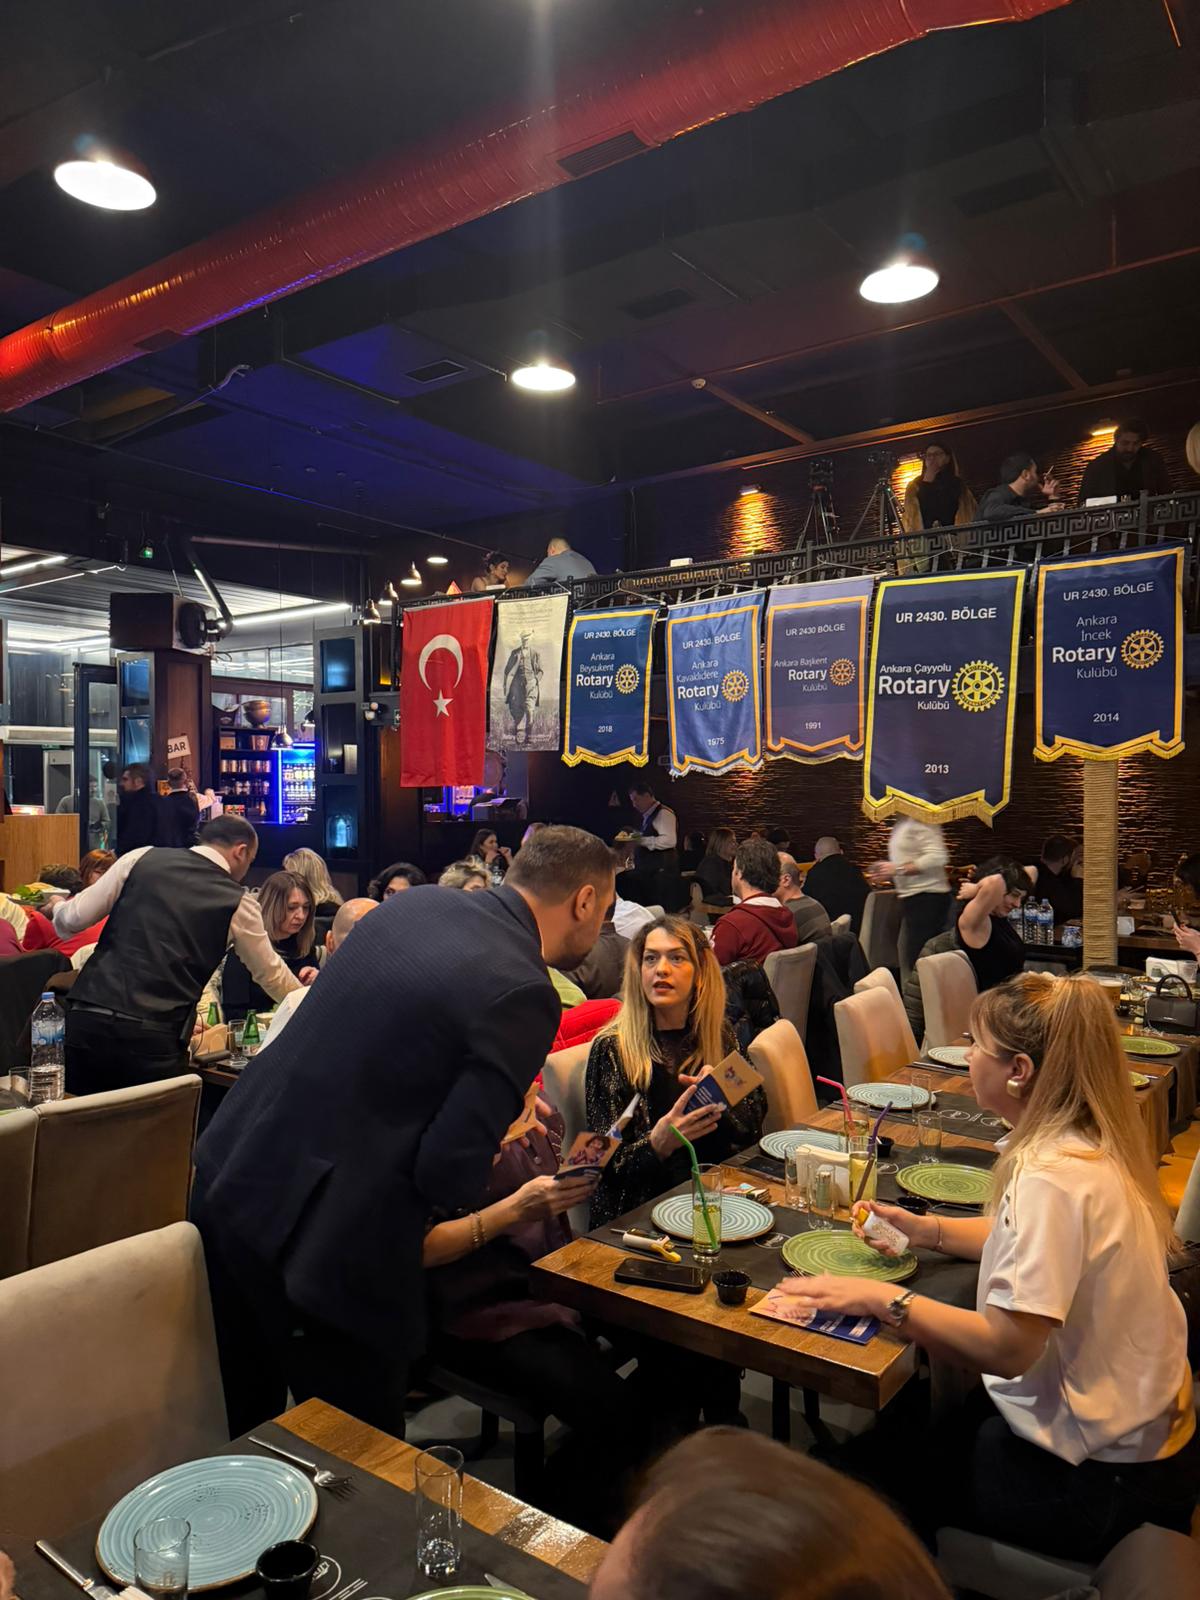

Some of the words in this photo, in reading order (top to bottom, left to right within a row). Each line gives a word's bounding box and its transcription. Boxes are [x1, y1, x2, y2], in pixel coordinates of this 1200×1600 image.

[1063, 591, 1080, 601] UR
[1082, 588, 1110, 599] 2430.
[1114, 581, 1154, 596] BÖLGE
[896, 612, 913, 623] UR
[916, 610, 948, 622] 2430.
[951, 607, 997, 621] BÖLGE
[1076, 615, 1117, 627] Ankara
[584, 631, 594, 639] UR
[595, 630, 612, 638] 2430.
[613, 629, 636, 638] BÖLGE
[786, 628, 797, 636] UR
[818, 623, 845, 634] BÖLGE
[683, 641, 694, 649] UR
[714, 632, 741, 644] BÖLGE
[591, 652, 615, 661] Ankara
[1052, 647, 1116, 663] Rotary
[692, 660, 718, 670] Ankara
[774, 658, 798, 667] Ankara
[580, 664, 614, 673] Beysukent
[880, 664, 912, 673] Ankara
[914, 663, 951, 675] Çayyolu
[1077, 666, 1118, 679] Kulübü
[576, 674, 613, 687] Rotary
[788, 669, 827, 681] Rotary
[677, 684, 719, 699] Rotary
[878, 676, 950, 698] Rotary
[590, 690, 613, 699] Kulübü
[918, 701, 950, 710] Kulübü
[1093, 713, 1120, 722] 2014
[598, 725, 612, 733] 2018
[708, 737, 724, 746] 1975
[168, 742, 186, 753] BAR
[924, 764, 949, 774] 2013
